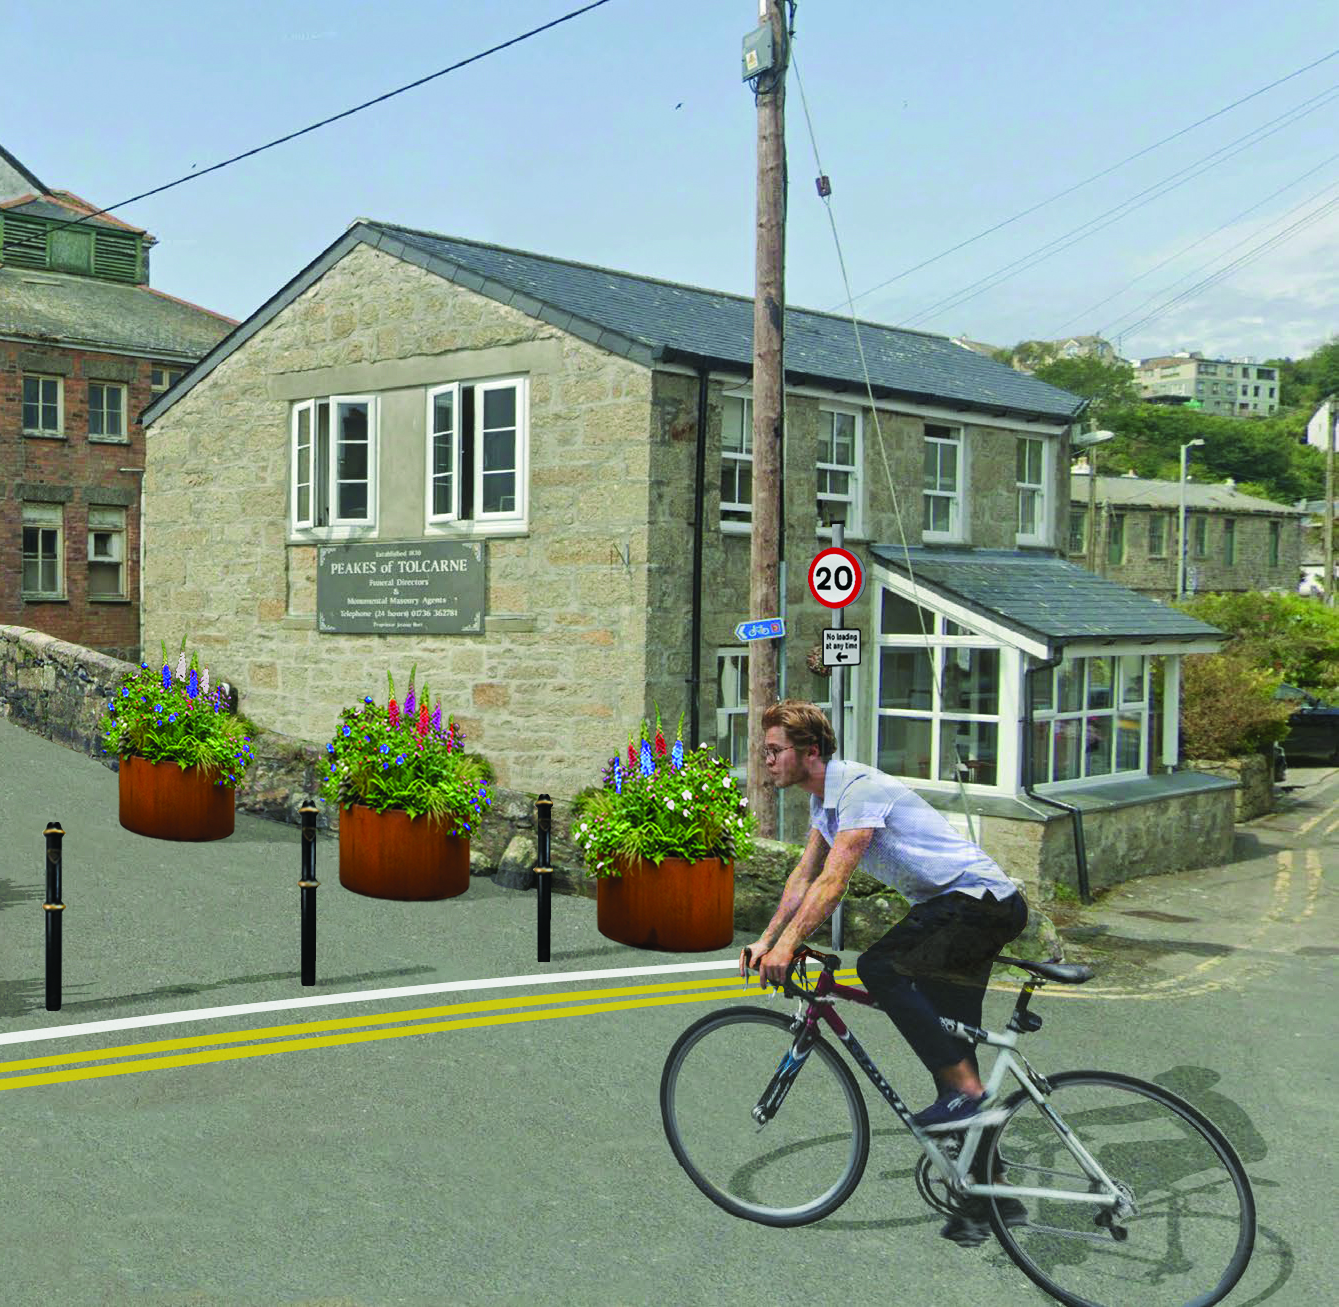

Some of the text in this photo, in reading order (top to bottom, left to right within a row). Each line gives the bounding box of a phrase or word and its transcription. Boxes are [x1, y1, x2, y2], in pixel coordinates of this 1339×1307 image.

[330, 559, 468, 575] PEAKES of TOLCARNE
[816, 566, 853, 591] 20
[347, 597, 446, 605] Monumental Masonry Agents
[341, 610, 372, 619] Telephone
[374, 610, 385, 619] (24
[387, 610, 409, 619] hours)
[826, 632, 857, 641] No loading
[825, 640, 858, 650] at any time
